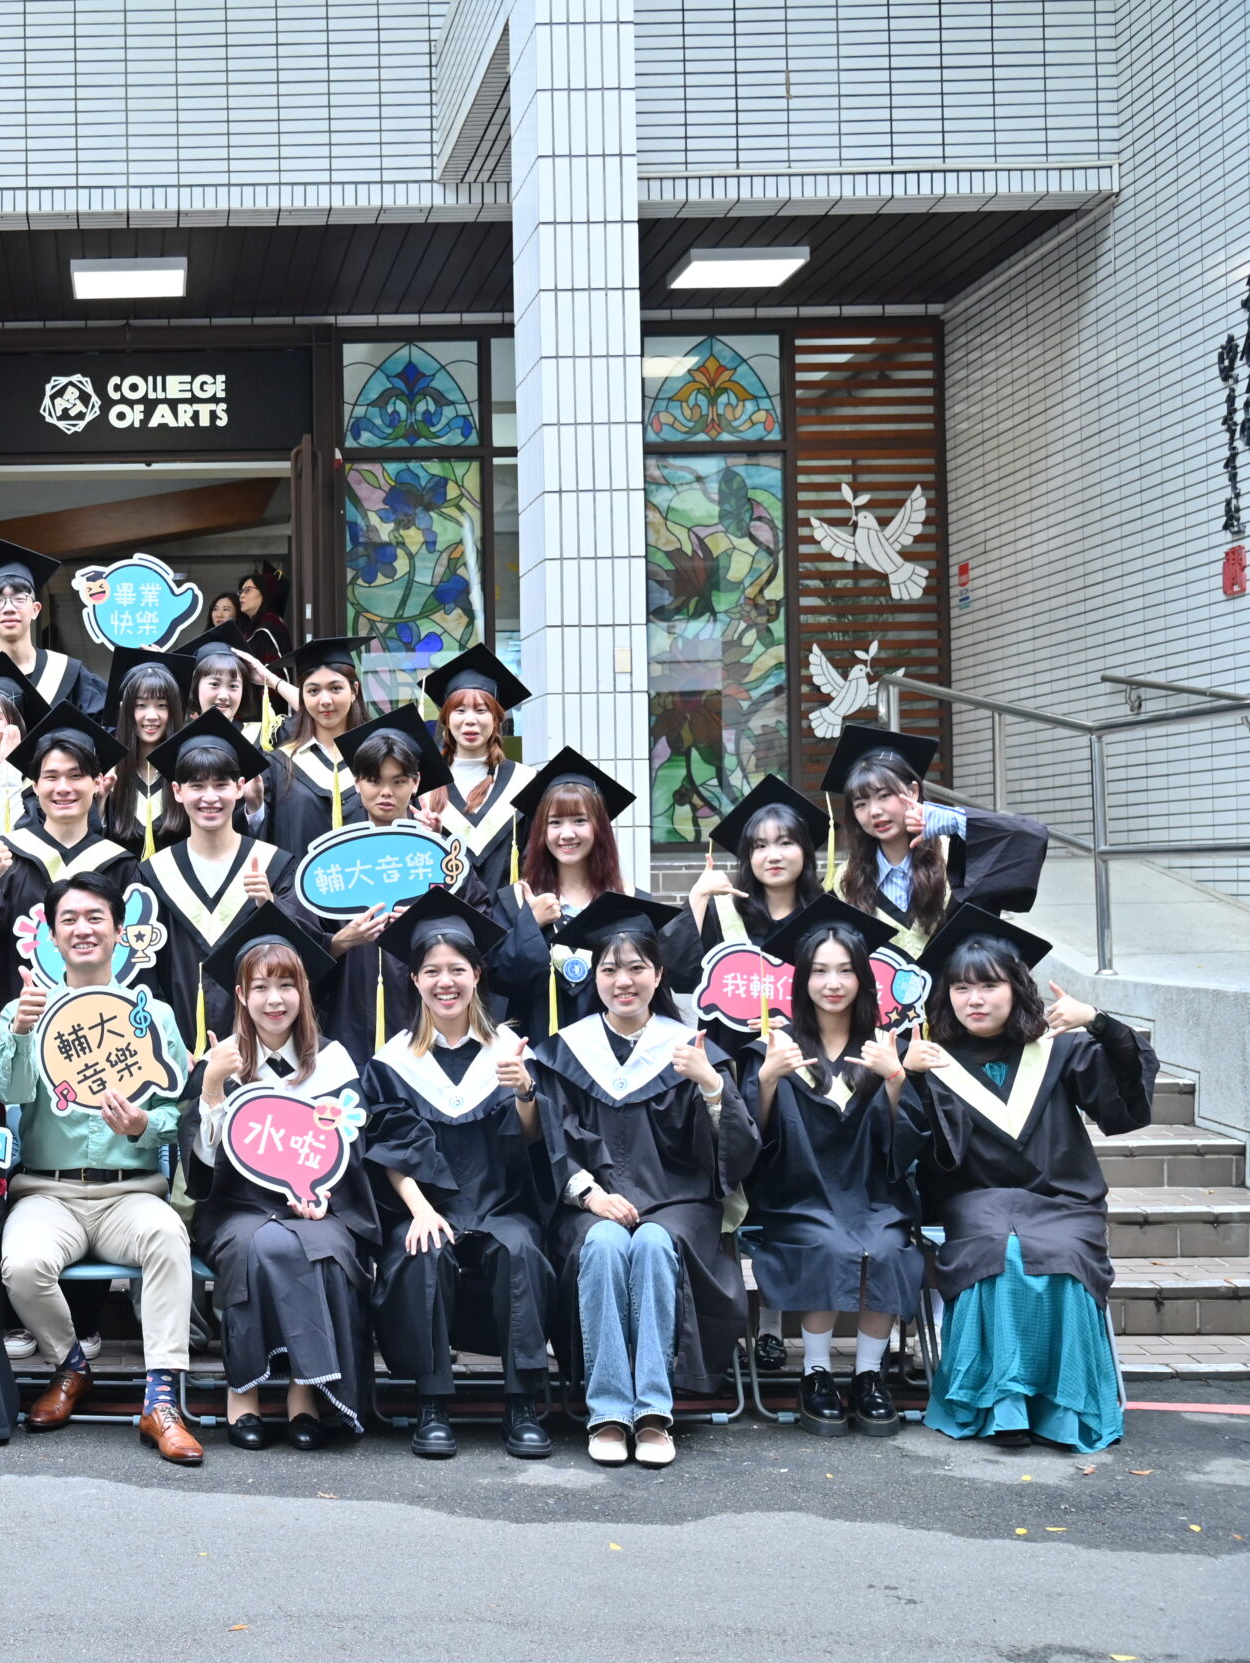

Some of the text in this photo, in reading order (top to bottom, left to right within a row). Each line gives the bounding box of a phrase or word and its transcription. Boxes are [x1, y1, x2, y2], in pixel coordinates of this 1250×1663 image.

[54, 385, 87, 417] ART
[107, 374, 226, 400] COLLEGE
[108, 402, 229, 429] OF ARTS
[113, 582, 162, 607] 畢業
[110, 610, 159, 636] 快樂
[313, 851, 435, 896] 輔大音樂
[54, 1012, 125, 1063] 輔大
[76, 1041, 143, 1096] 音樂
[243, 1114, 327, 1170] 水啦
